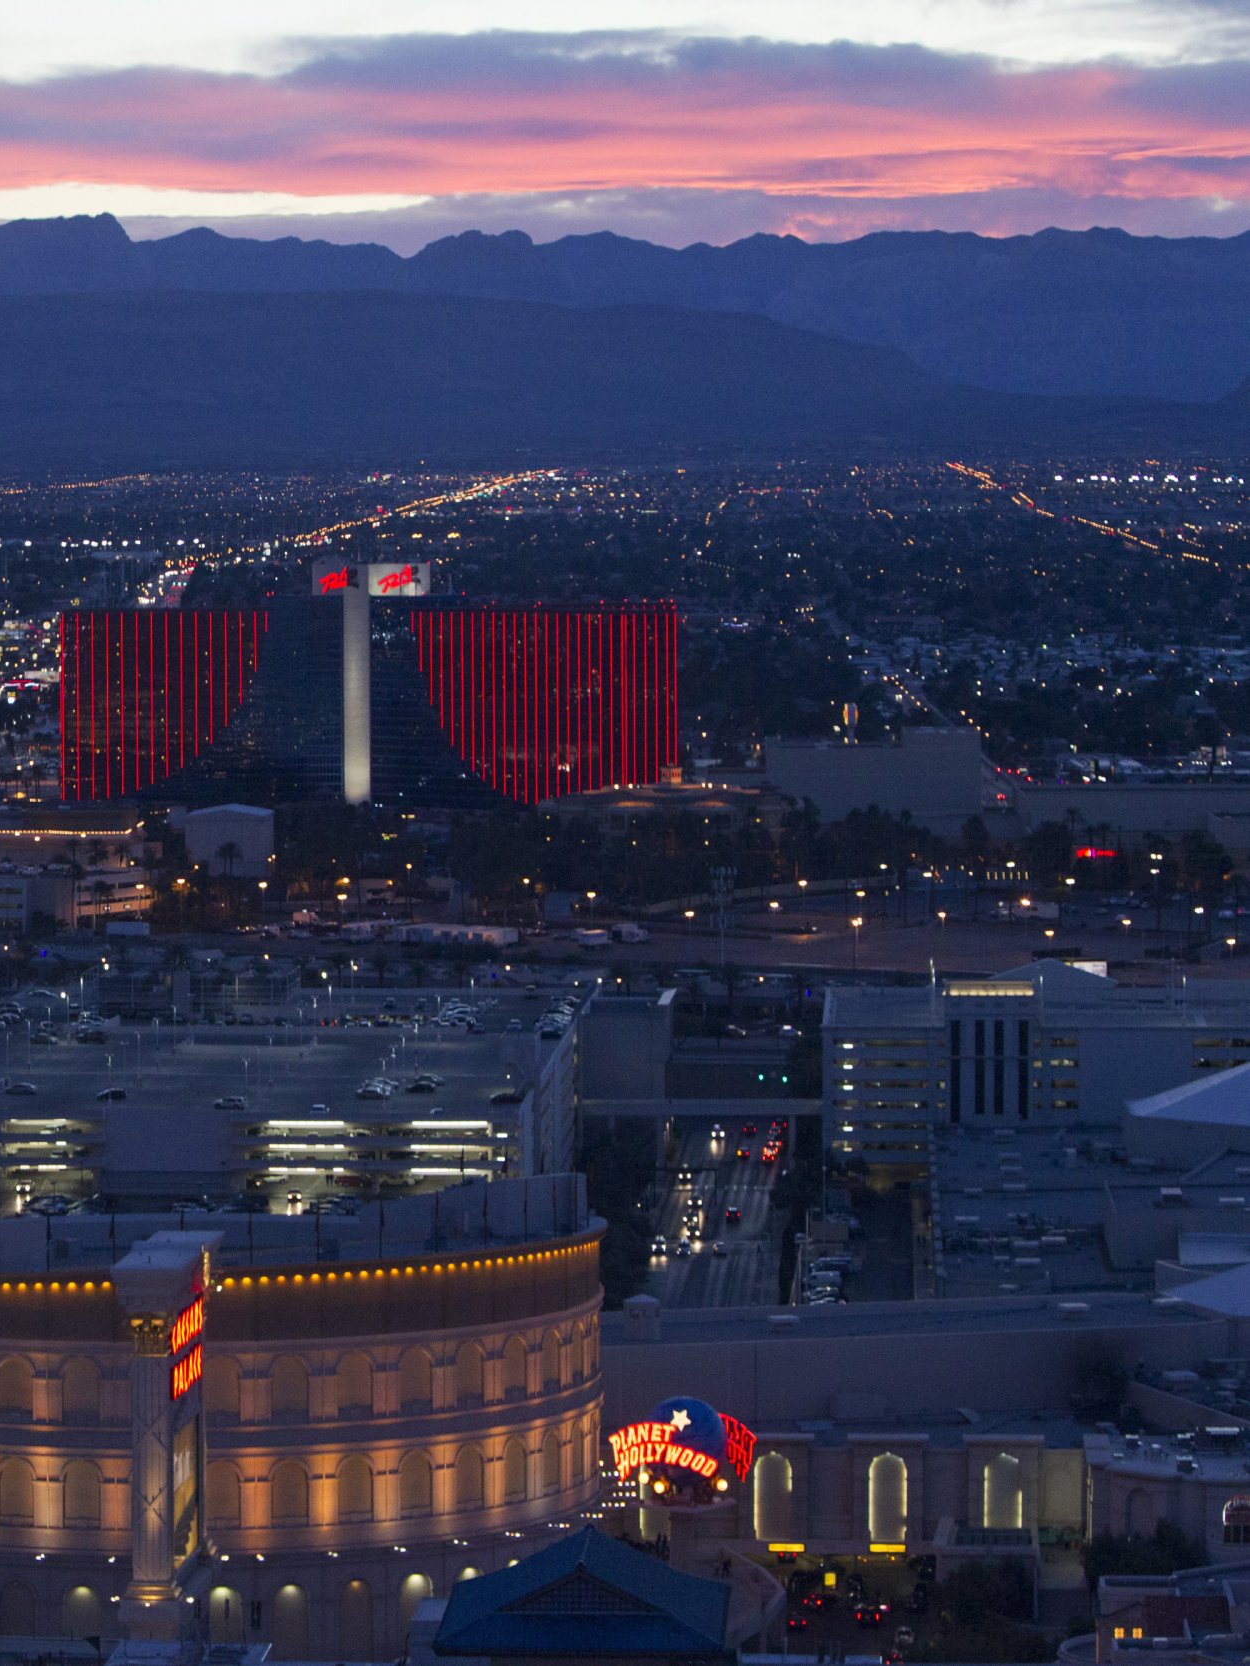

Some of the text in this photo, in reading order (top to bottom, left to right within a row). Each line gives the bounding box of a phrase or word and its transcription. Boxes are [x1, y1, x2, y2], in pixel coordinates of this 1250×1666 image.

[171, 1297, 204, 1356] CAESARS
[172, 1343, 203, 1402] PALACE
[608, 1421, 678, 1467] PLANET
[616, 1442, 719, 1482] HOLLYWOOD
